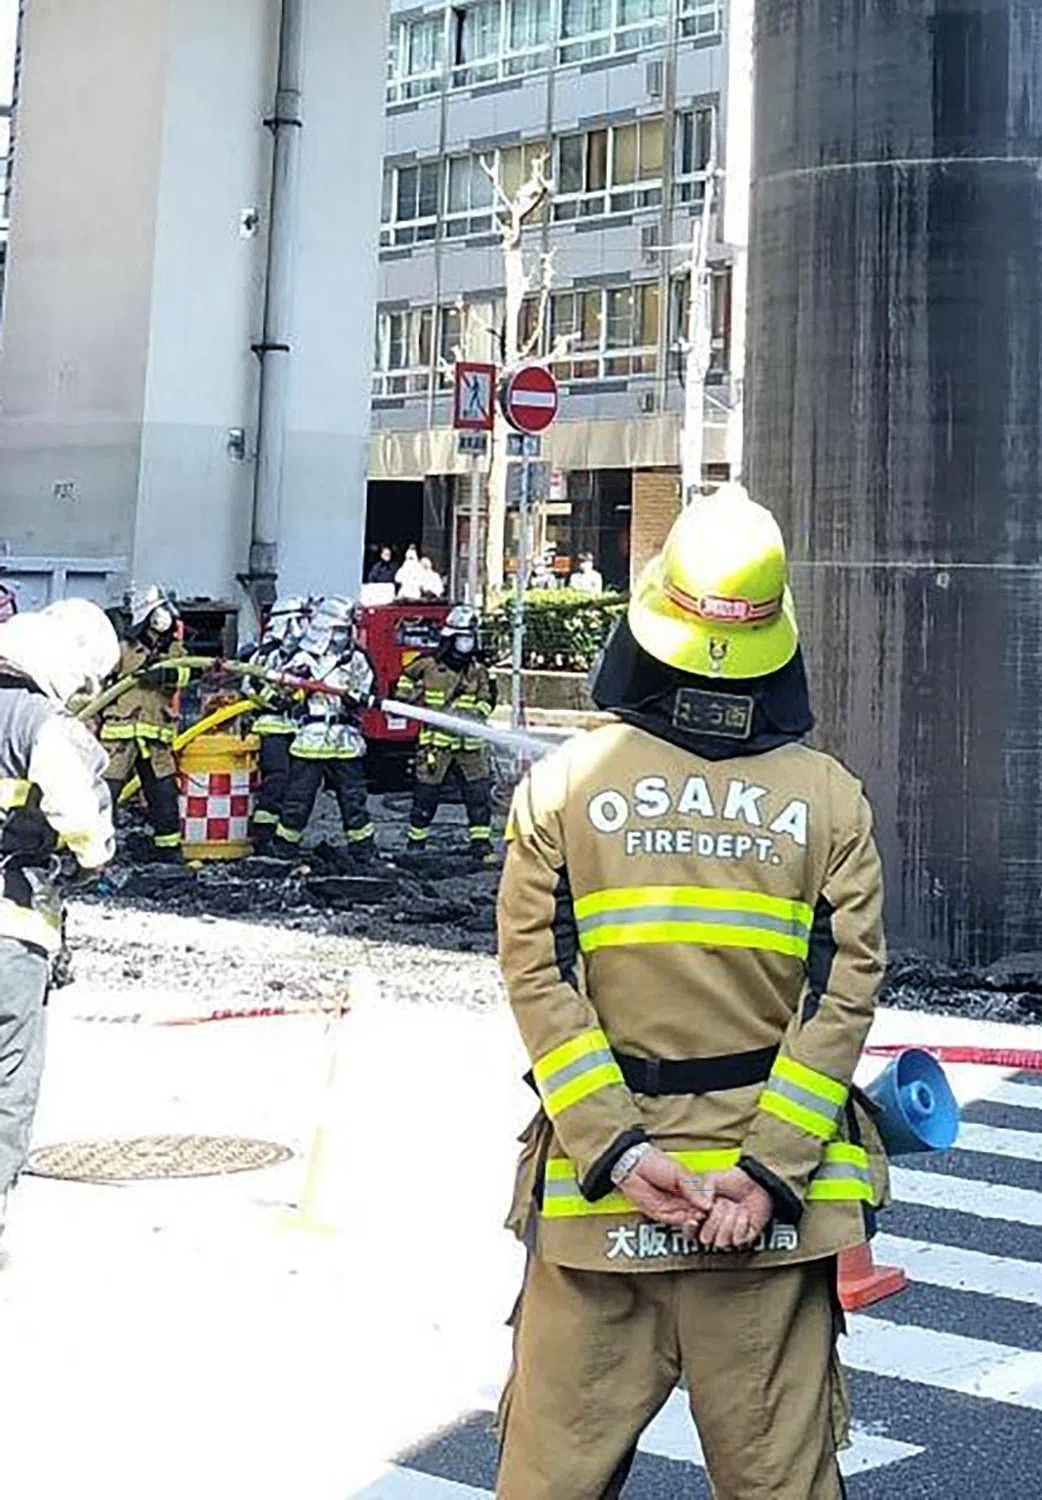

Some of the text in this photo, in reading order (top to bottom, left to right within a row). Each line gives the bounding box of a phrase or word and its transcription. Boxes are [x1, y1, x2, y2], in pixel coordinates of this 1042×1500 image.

[588, 775, 808, 846] OSAKA
[626, 830, 782, 864] FIRE DEPT.
